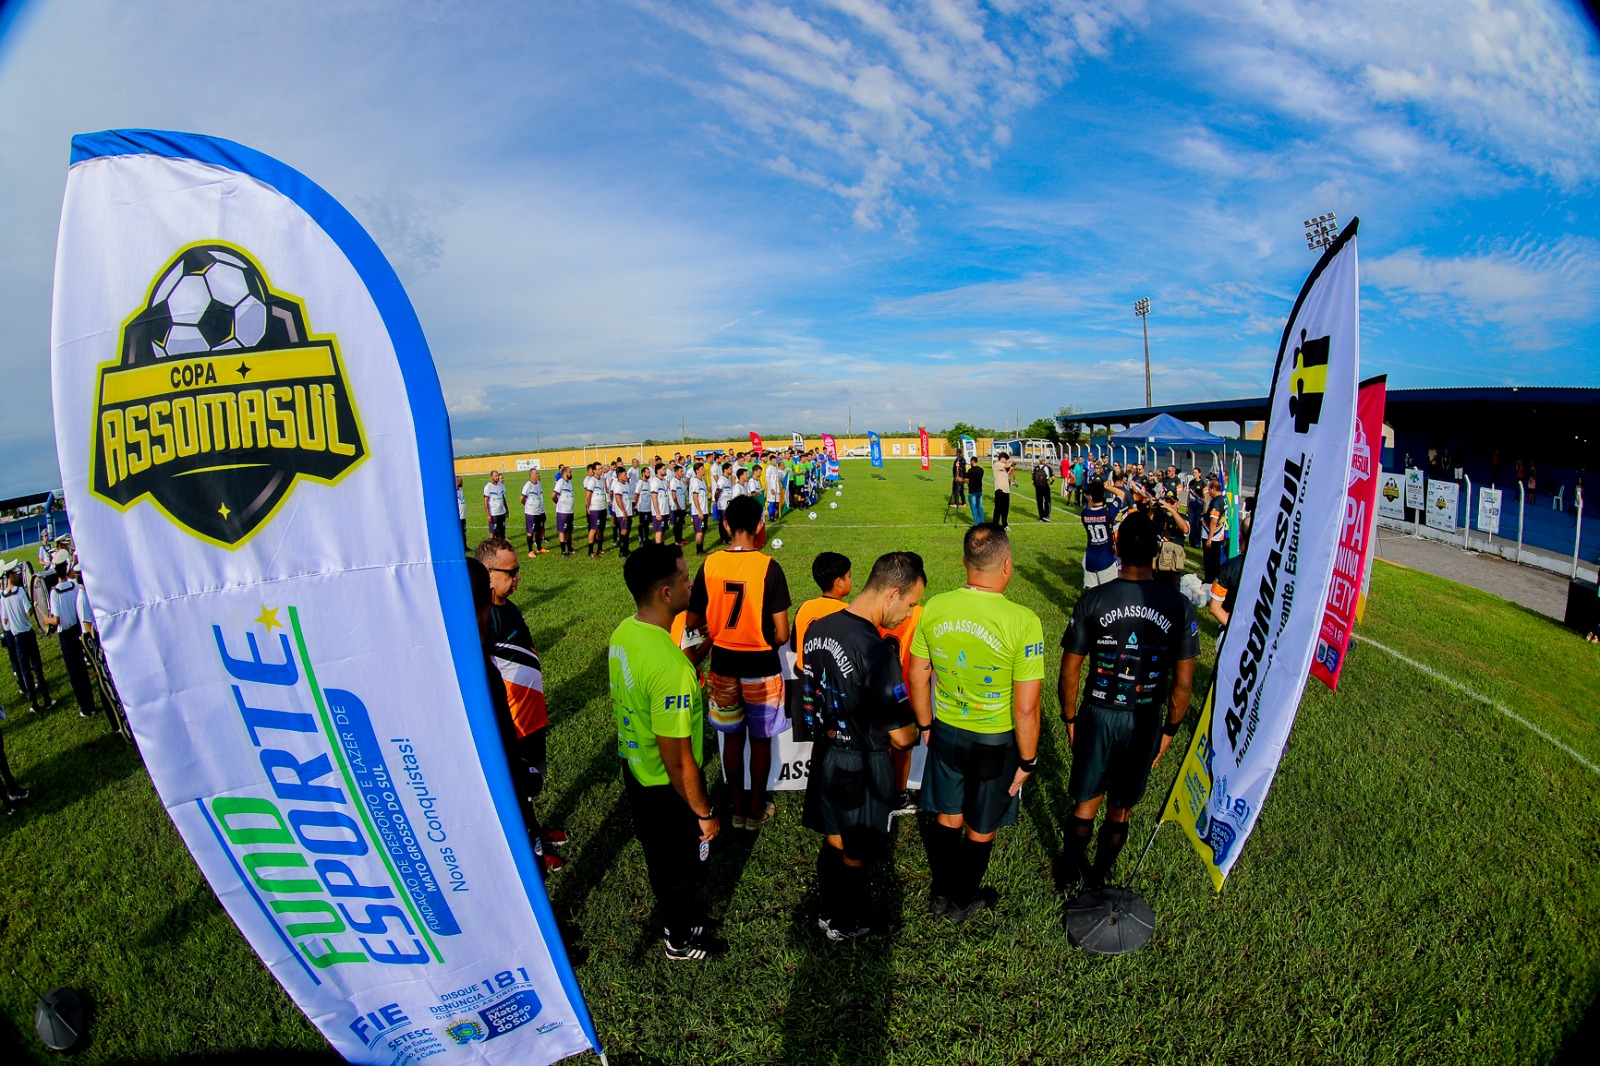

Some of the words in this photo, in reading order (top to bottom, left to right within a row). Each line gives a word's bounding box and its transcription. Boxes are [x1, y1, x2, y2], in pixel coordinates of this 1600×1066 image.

[170, 365, 218, 389] COPA
[102, 383, 356, 488] ASSOMASUL
[1087, 524, 1109, 543] 10
[1341, 496, 1366, 551] PA
[723, 580, 746, 630] 7
[1225, 452, 1306, 753] ASSOMASUL
[1328, 575, 1356, 616] IETY
[1099, 607, 1123, 628] COPA
[1123, 604, 1173, 634] ASSOMASUL
[933, 620, 955, 639] COPA
[955, 619, 1004, 653] ASSOMASUL
[1235, 654, 1273, 769] Municipal
[1285, 509, 1302, 577] Estado
[803, 636, 821, 655] COPA
[821, 636, 855, 679] ASSOMASUL
[1024, 641, 1044, 658] FIE
[664, 693, 691, 710] FIE
[892, 682, 908, 701] FI
[335, 704, 349, 726] DE
[343, 732, 369, 774] LAZER
[371, 764, 391, 789] SUL
[778, 759, 812, 782] ASS
[212, 624, 431, 965] ESPORTE
[360, 780, 373, 788] E
[390, 737, 447, 843] Conquistas!
[382, 791, 400, 811] DO
[368, 794, 403, 856] DESPORTO
[392, 813, 422, 862] GROSSO
[397, 860, 413, 875] DE
[419, 864, 438, 893] MATO
[439, 846, 470, 893] Novas
[211, 796, 370, 970] FUND
[406, 878, 440, 930] FUNDAÇÃO
[440, 983, 479, 1002] DISQUE
[481, 967, 530, 995] 181
[429, 992, 485, 1014] DENÚNCIA
[460, 1004, 479, 1014] NÃO
[485, 998, 515, 1015] GOVERNO
[487, 1004, 518, 1022] Mato
[348, 1003, 410, 1046] FIE
[492, 1005, 531, 1027] Grosso
[497, 1023, 513, 1033] do
[513, 1013, 530, 1027] Sul
[388, 1028, 433, 1052] SETESC
[412, 1036, 438, 1046] Estado
[414, 1043, 442, 1054] Esporte
[420, 1048, 447, 1059] Cultura
